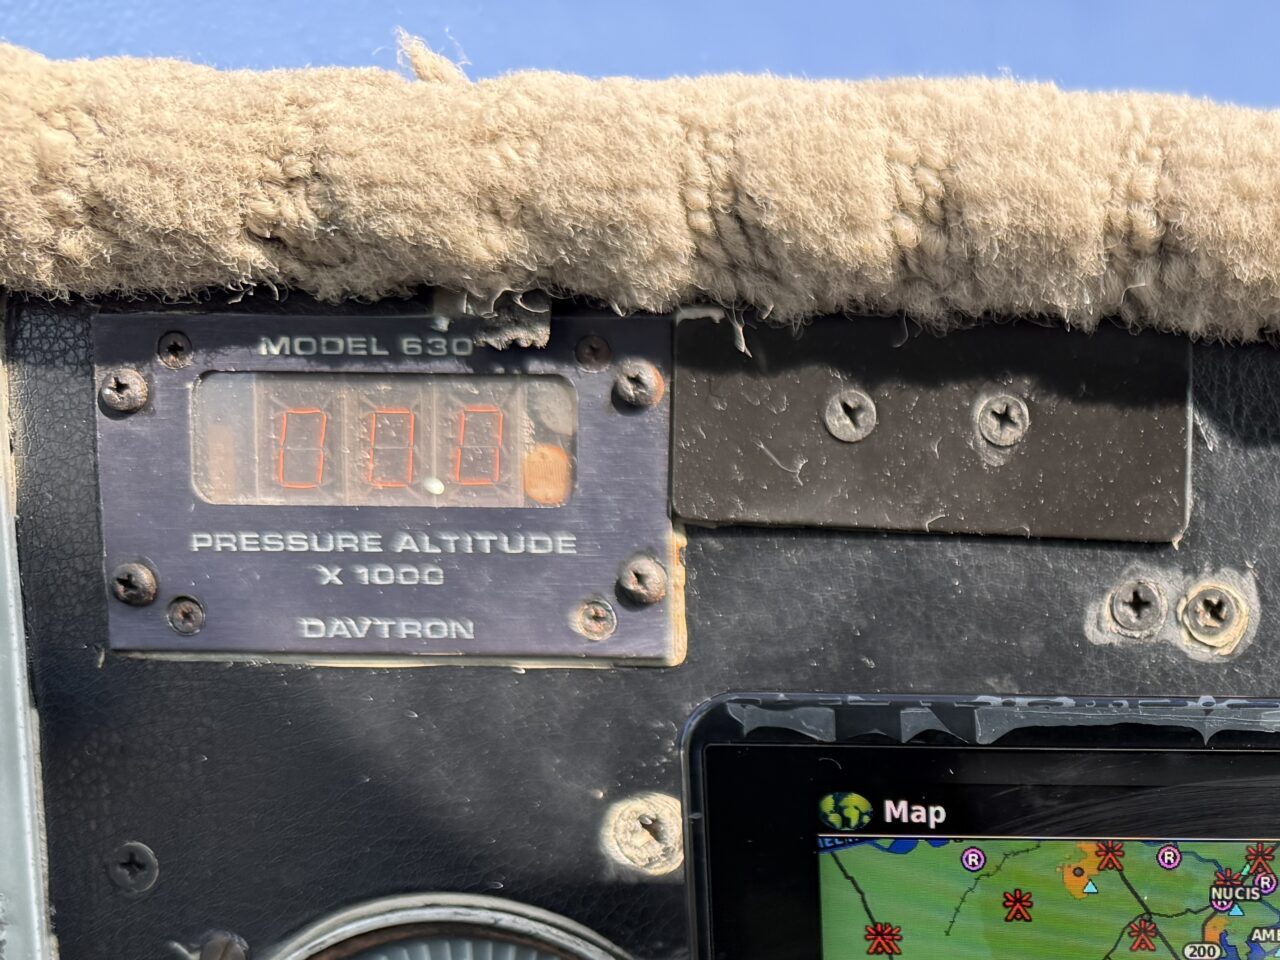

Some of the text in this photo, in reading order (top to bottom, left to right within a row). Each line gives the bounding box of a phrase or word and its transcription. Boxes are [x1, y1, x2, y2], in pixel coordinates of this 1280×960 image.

[259, 337, 475, 356] MODEL 630
[191, 533, 578, 555] PRESSURE ALTITUDE
[317, 566, 445, 586] X 1000
[298, 619, 475, 640] DAVTRON
[884, 799, 947, 829] Map
[1211, 887, 1261, 900] NUCIS
[1188, 945, 1217, 958] 200
